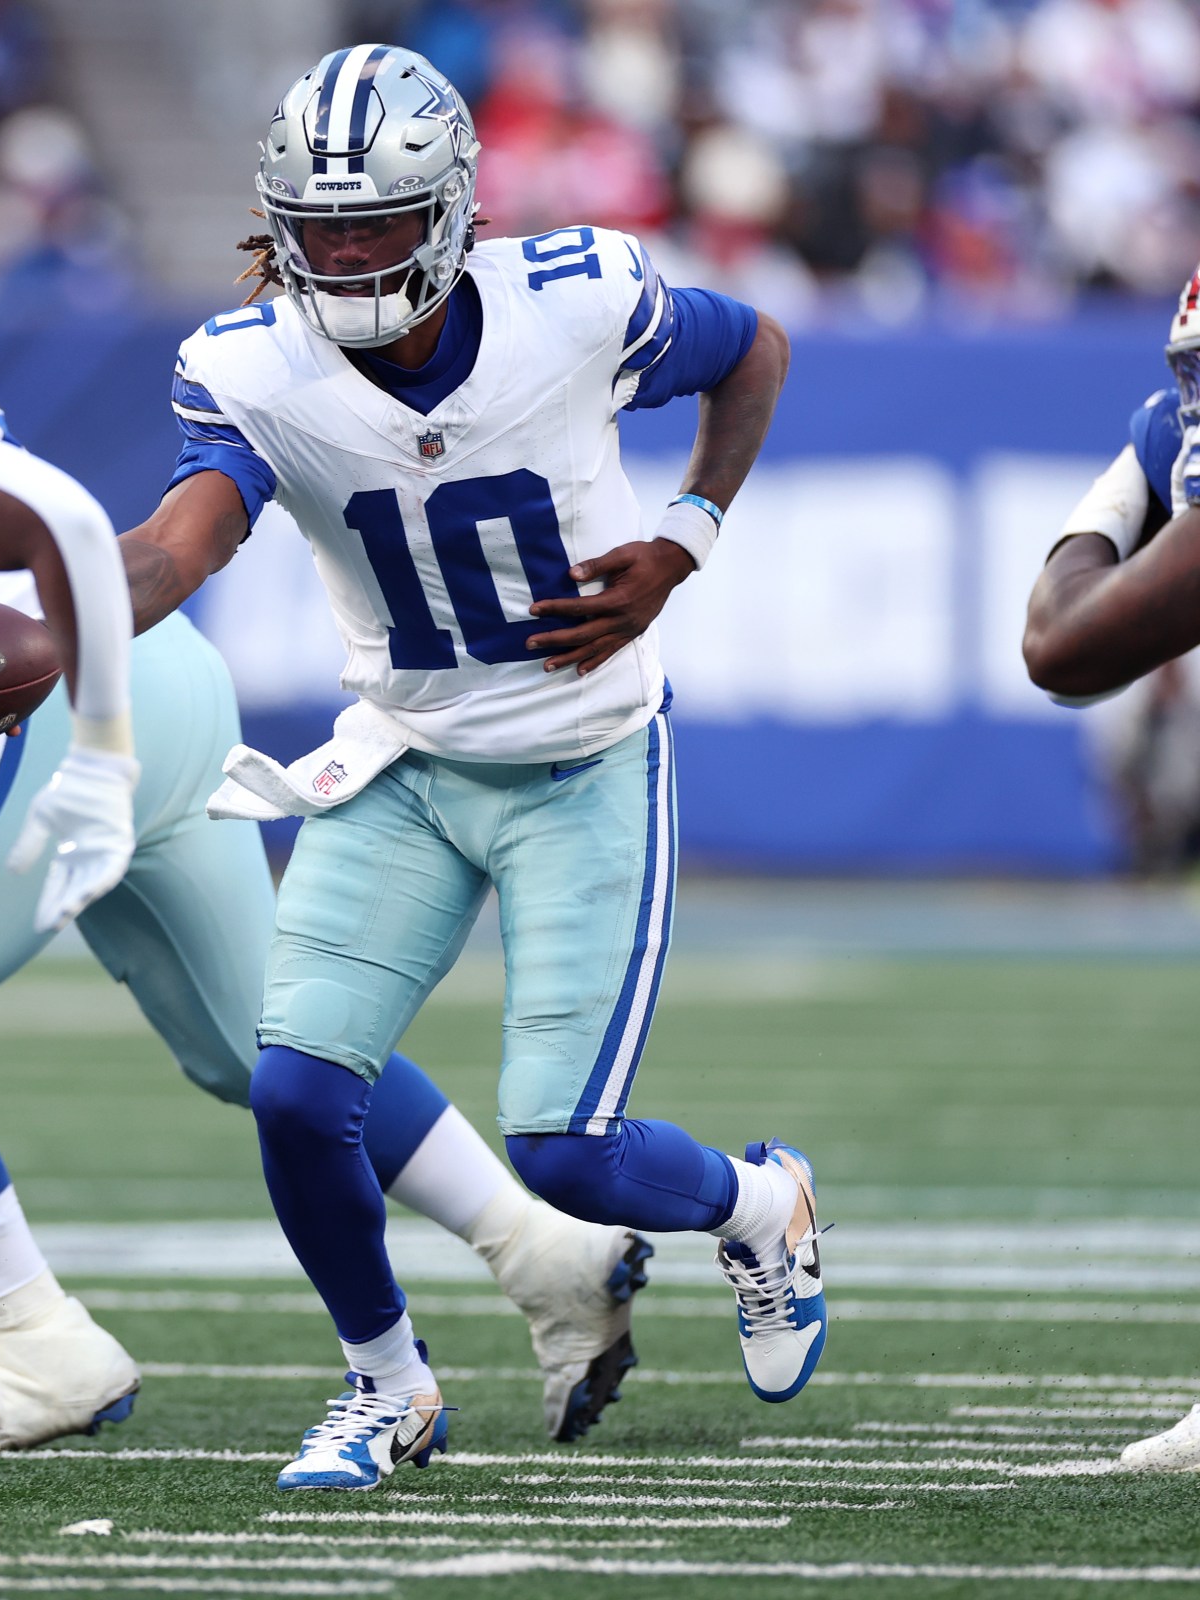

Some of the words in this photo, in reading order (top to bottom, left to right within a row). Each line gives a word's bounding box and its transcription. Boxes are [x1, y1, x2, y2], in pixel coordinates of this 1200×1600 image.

[315, 181, 362, 191] COWBOYS
[521, 226, 603, 292] 10
[422, 442, 443, 456] NFL
[343, 467, 590, 671] 10
